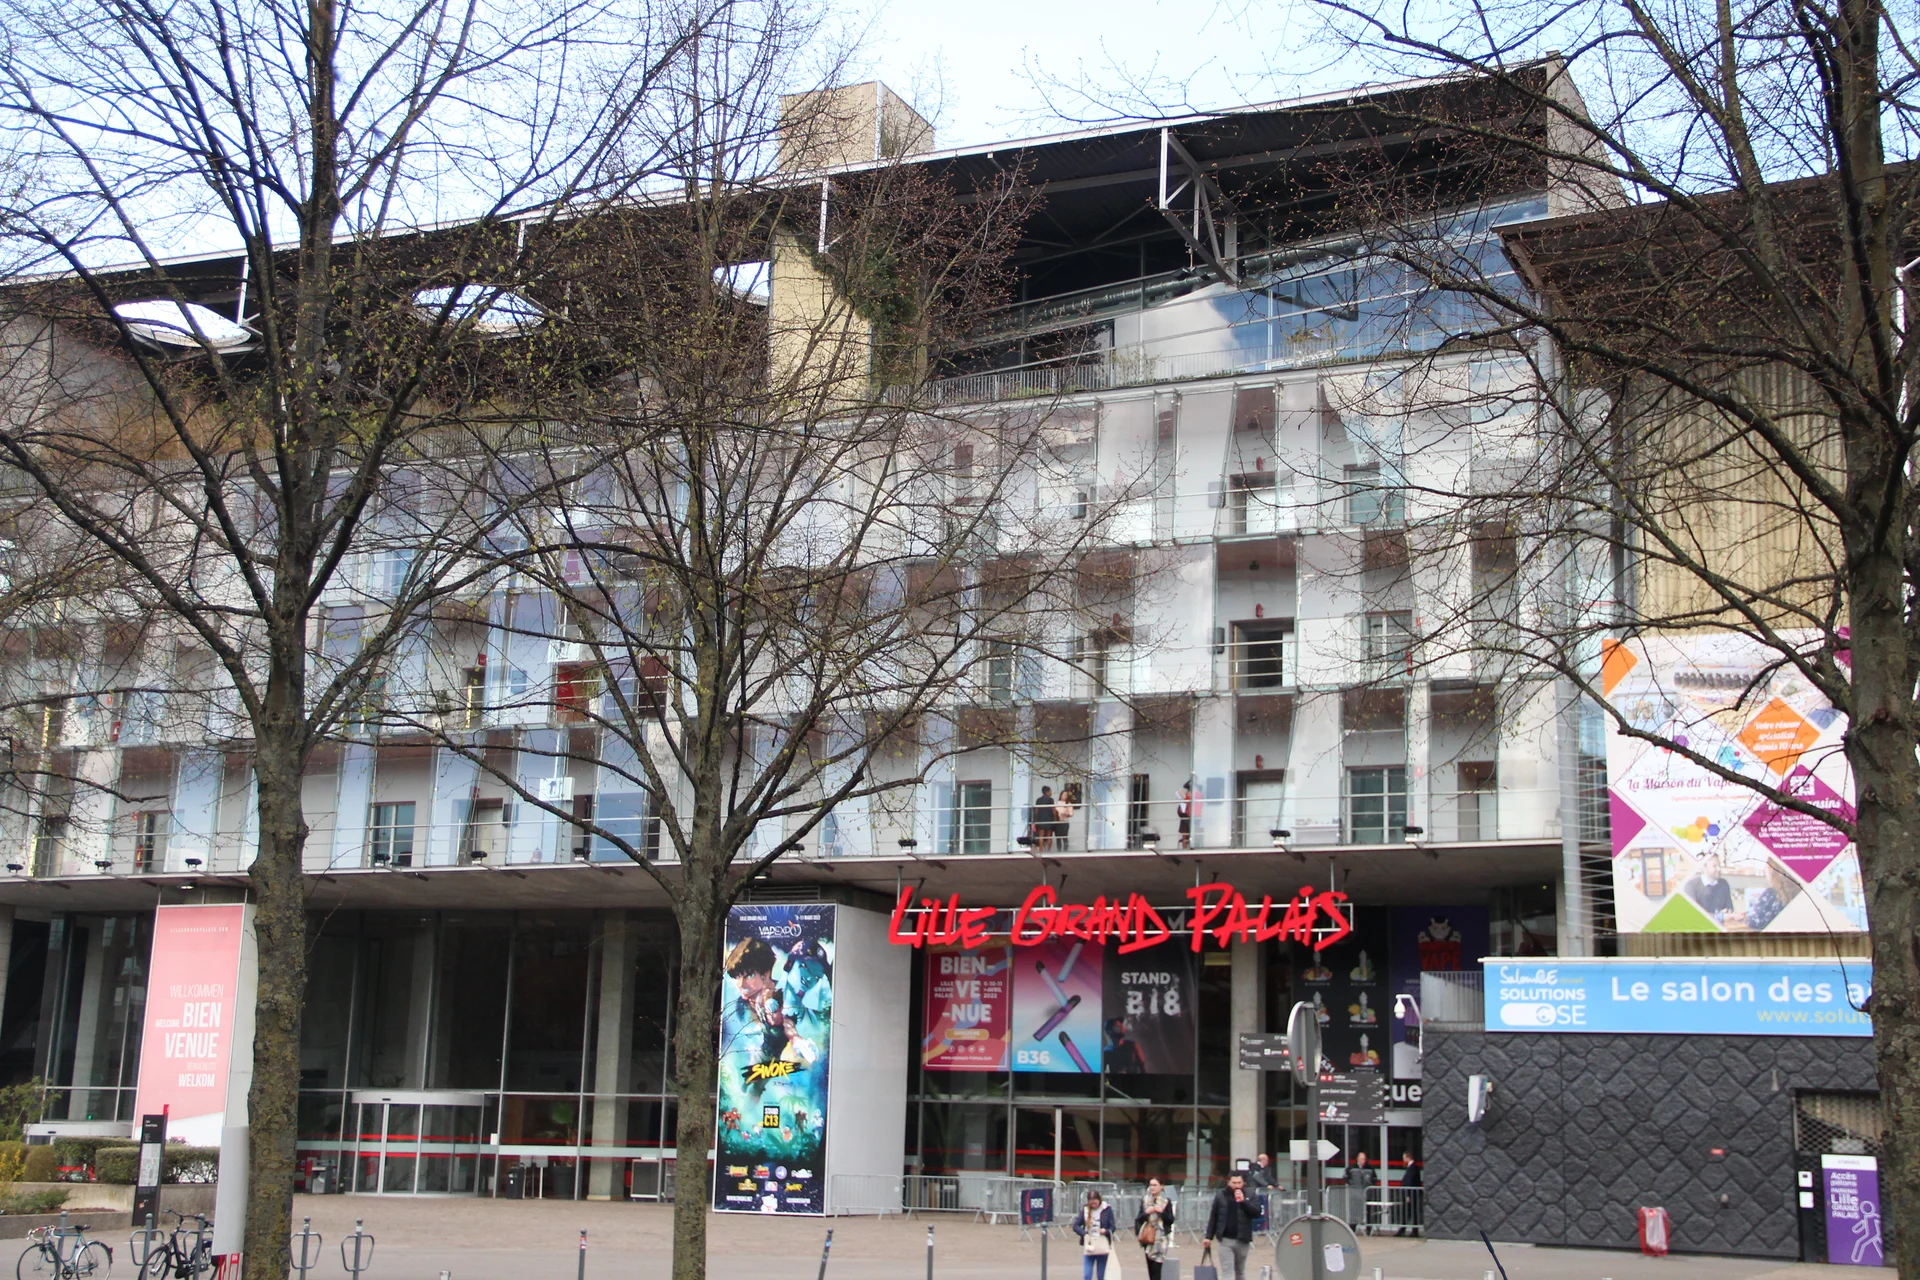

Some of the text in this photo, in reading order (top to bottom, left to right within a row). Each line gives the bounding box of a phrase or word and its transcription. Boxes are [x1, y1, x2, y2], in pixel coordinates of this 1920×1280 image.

[1754, 721, 1774, 730] Votre
[1779, 741, 1789, 750] 10
[1627, 778, 1640, 792] La
[1643, 777, 1684, 790] Maison
[1686, 778, 1701, 788] du
[1011, 884, 1171, 955] GRAND
[1121, 972, 1171, 985] STAND
[169, 983, 225, 999] WILLKOMMEN
[955, 980, 981, 998] VE
[1500, 988, 1587, 1001] SOLUTIONS
[1611, 976, 1650, 1002] Le
[1661, 975, 1755, 1002] salon
[1767, 976, 1834, 1003] des
[182, 1002, 222, 1028] BIEN
[165, 1032, 219, 1058] VENUE
[1017, 1050, 1050, 1065] B36
[746, 1057, 795, 1085] SWOKE
[178, 1073, 216, 1087] WELKOM
[764, 1114, 779, 1127] C13
[1830, 1172, 1857, 1180] Accès
[1831, 1193, 1859, 1204] Lille
[1832, 1211, 1860, 1219] PALAIS
